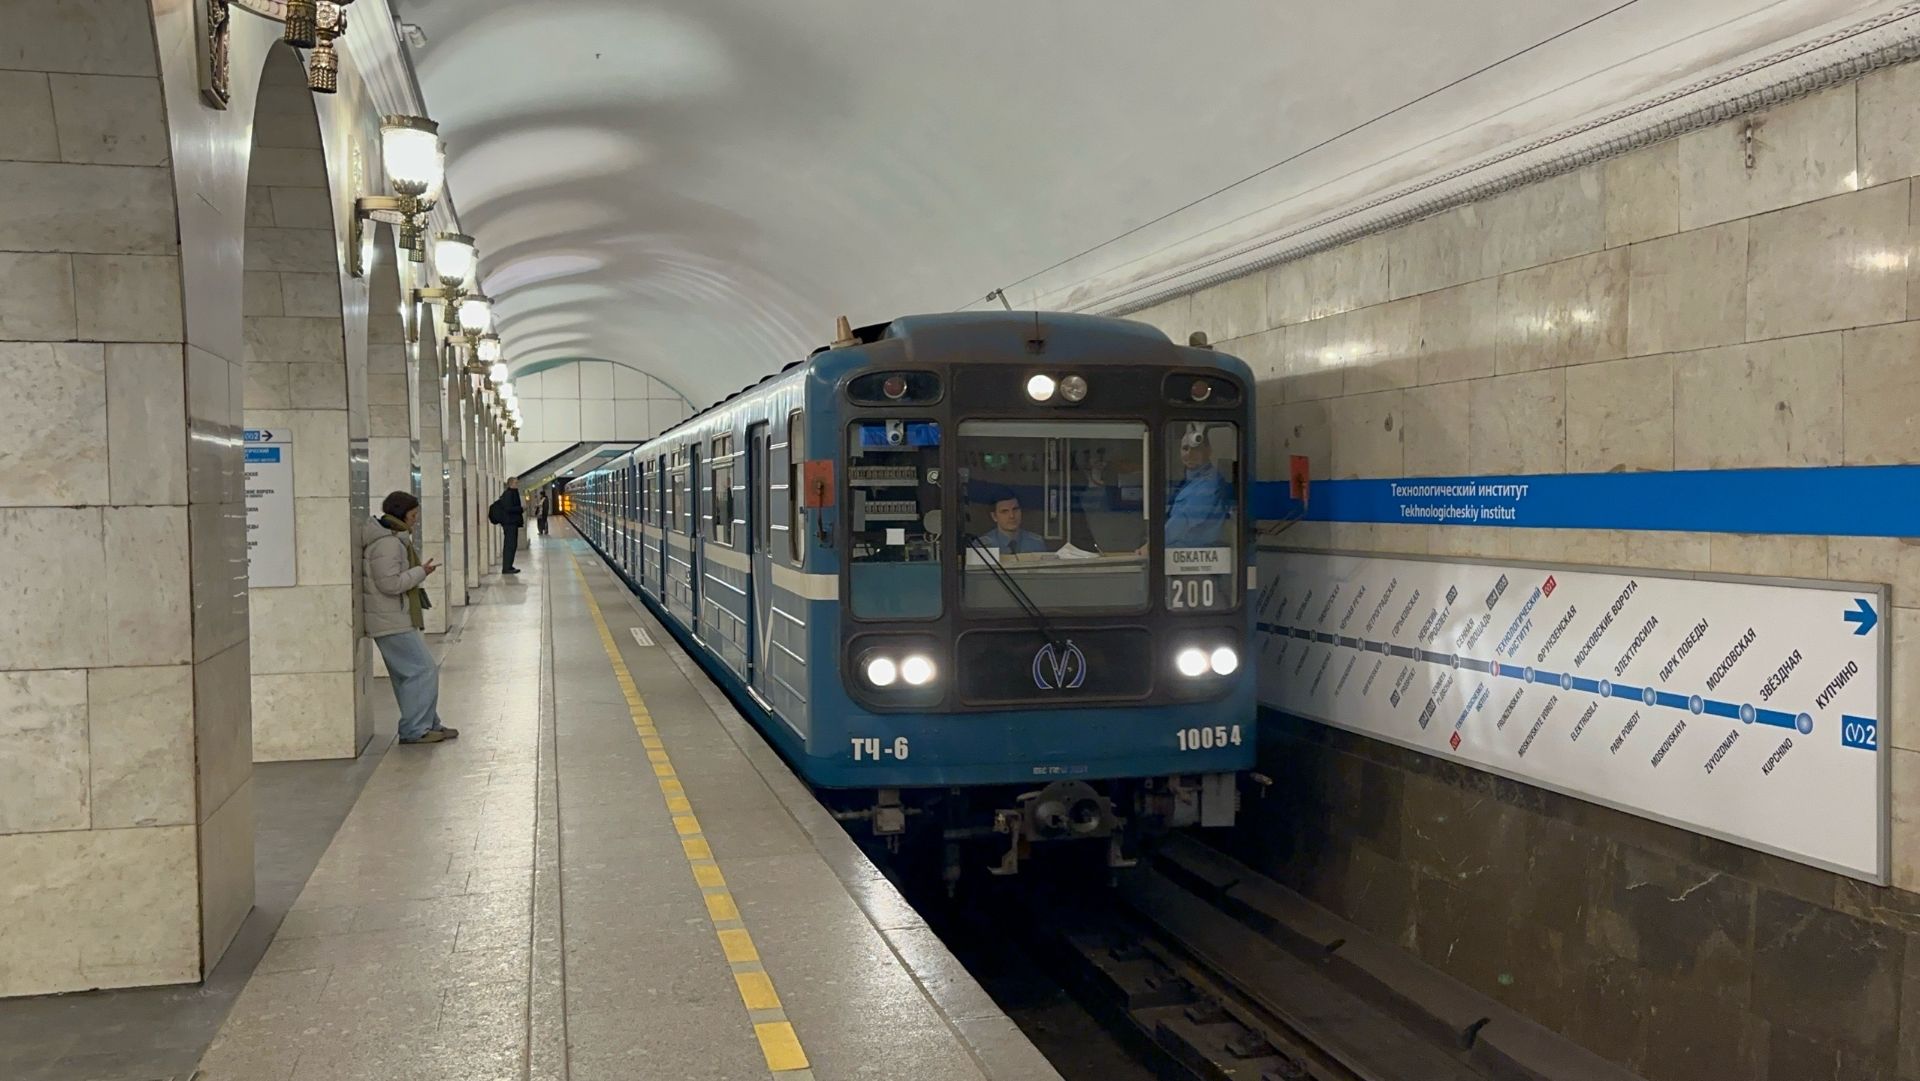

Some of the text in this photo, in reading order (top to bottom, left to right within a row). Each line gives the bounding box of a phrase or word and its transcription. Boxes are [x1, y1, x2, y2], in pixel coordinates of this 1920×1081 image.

[1391, 481, 1529, 501] Технологический институт
[1400, 504, 1516, 522] Tekhnologicheskiy institut
[1173, 550, 1218, 563] ОБКАТКА
[1172, 579, 1214, 608] 200
[1417, 607, 1439, 643] НЕВСКИЙ
[1427, 606, 1451, 645] ПРОСПЕКТ
[1456, 617, 1475, 649] СЕННАЯ
[1467, 612, 1492, 651] ПЛОЩАДЬ
[1496, 586, 1542, 656] ТЕХНОЛОГИЧЕСКИЙ
[1507, 618, 1534, 658] ИНСТИТУТ
[1536, 604, 1577, 663] ФРУНЗЕНСКАЯ
[1573, 580, 1638, 668] МОСКОВСКИЕ ВОРОТА
[1614, 615, 1659, 677] ЭЛЕКТРОСИЛА
[1659, 617, 1709, 683] ПАРК ПОБЕДЫ
[1706, 627, 1757, 692] МОСКОВСКАЯ
[1759, 649, 1803, 702] ЗВЁЗДНАЯ
[1815, 660, 1859, 710] КУПЧИНО
[1496, 687, 1525, 731] FRUNZENSKAYA
[1541, 695, 1558, 722] VOROTA
[1570, 700, 1599, 742] ELEKTROSILA
[1176, 724, 1242, 751] 10054
[1609, 710, 1642, 755] PARK POBEDY
[1650, 719, 1687, 769] MOSKOVSKAYA
[1703, 729, 1740, 775] ZVYOZDNAYA
[1761, 737, 1793, 776] KUPCHINO
